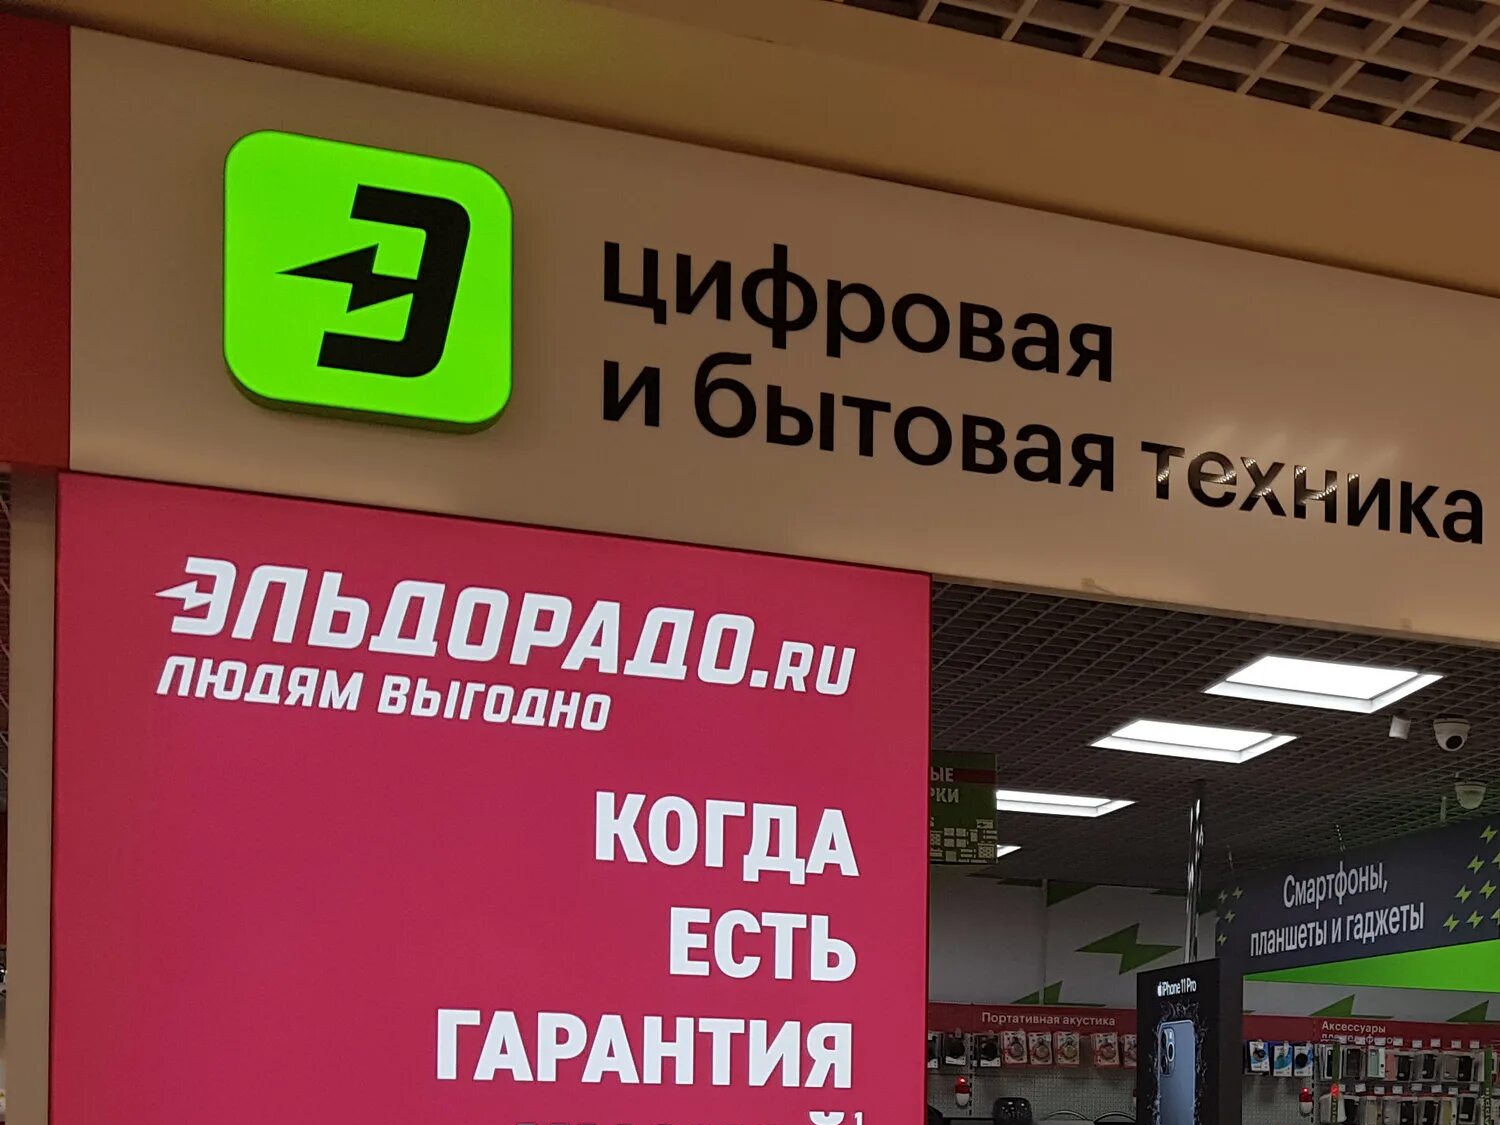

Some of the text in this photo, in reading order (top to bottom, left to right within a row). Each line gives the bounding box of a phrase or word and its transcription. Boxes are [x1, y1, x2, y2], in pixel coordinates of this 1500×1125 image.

[602, 241, 1114, 382] цифровая
[602, 351, 1486, 546] и бытовая техника
[155, 555, 857, 697] ЭЛЬДОРАДО.RU
[155, 653, 613, 733] ЛЮДЯМ ВЫГОДНО
[595, 790, 860, 885] КОГДА
[1282, 859, 1389, 910] Смартфоны,
[668, 905, 857, 983] ЕСТЬ
[1249, 901, 1425, 958] планшеты и гаджеты
[981, 1011, 1116, 1028] Портативная акустика
[1158, 981, 1181, 997] iPhone
[1186, 977, 1197, 993] Pro
[436, 1008, 853, 1089] ГАРАНТИЯ
[1321, 1019, 1387, 1035] Аксессуары
